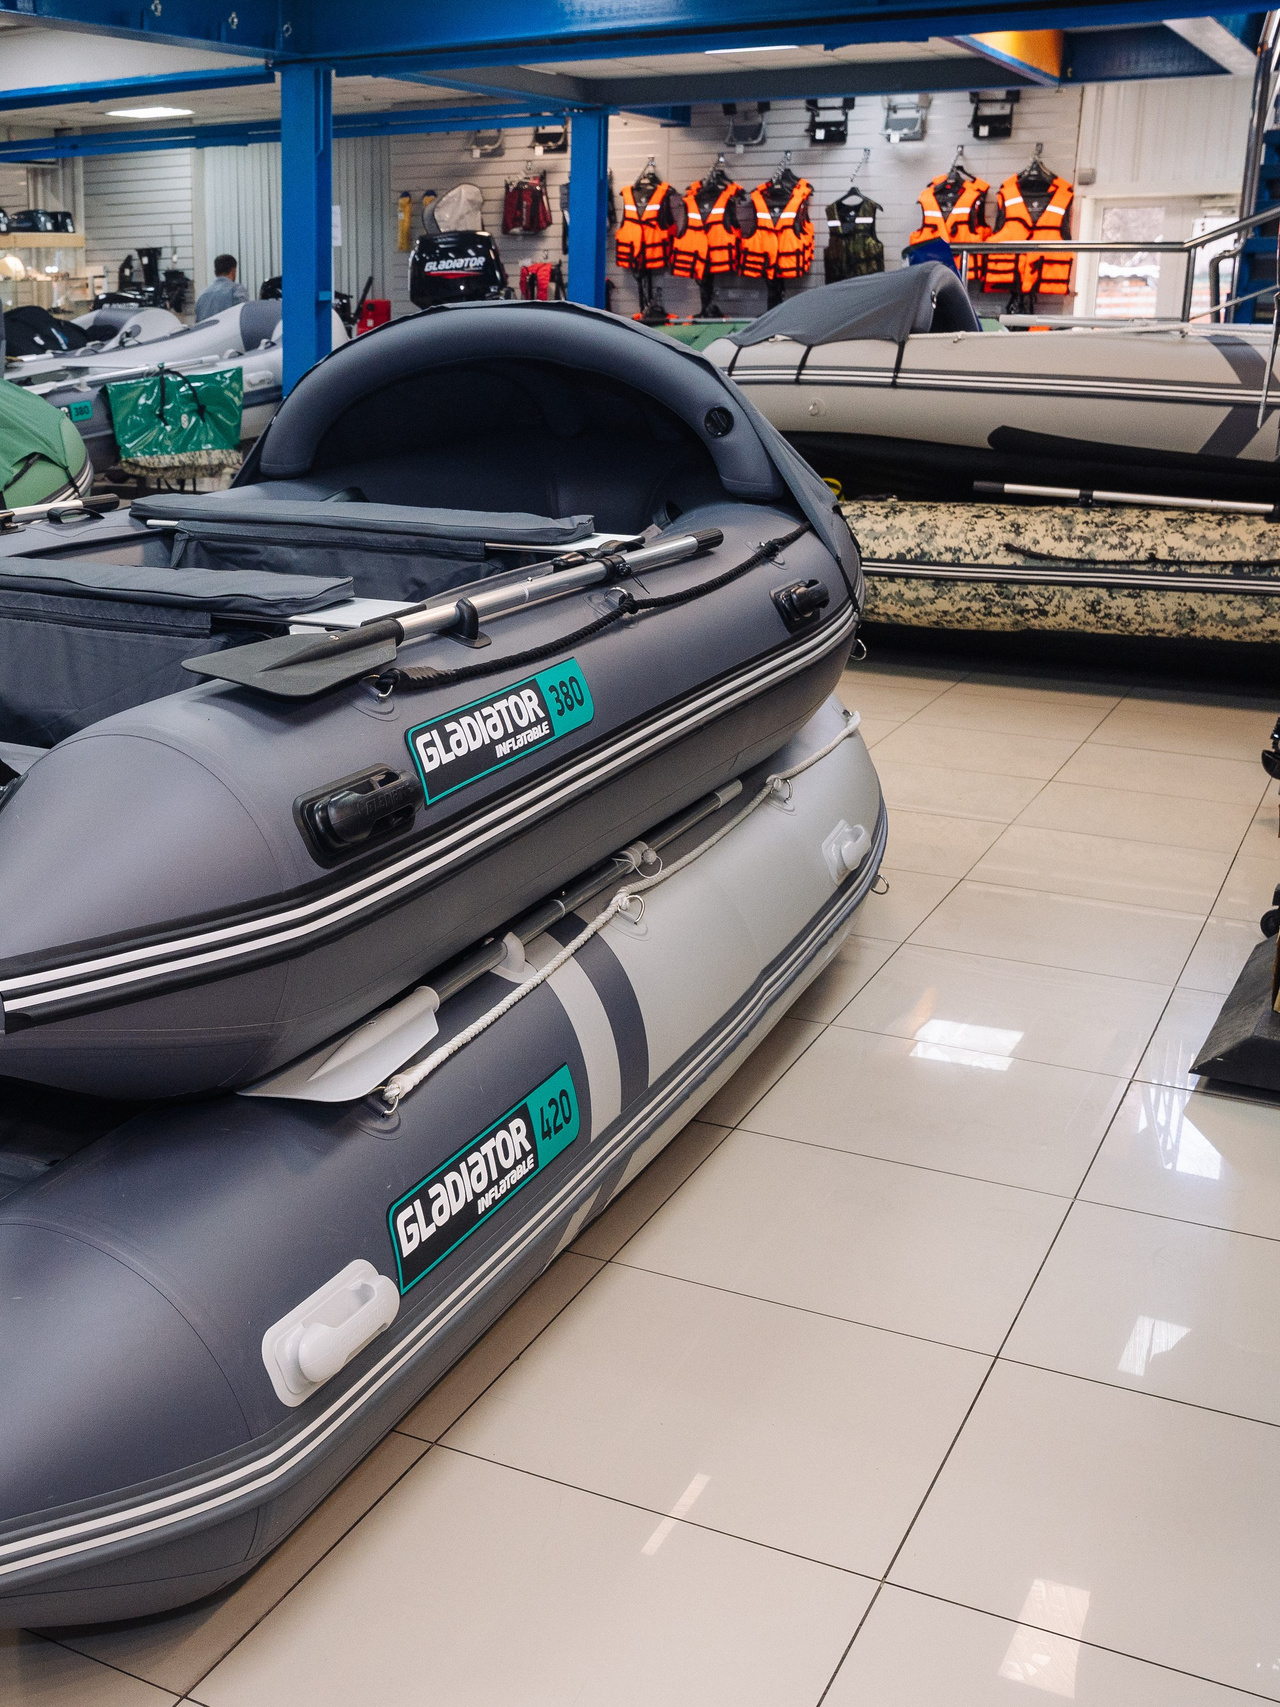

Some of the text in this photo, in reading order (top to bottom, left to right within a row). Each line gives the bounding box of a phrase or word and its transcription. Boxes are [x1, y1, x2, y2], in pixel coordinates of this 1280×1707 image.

[424, 256, 486, 272] GLADIATOR
[415, 676, 585, 773] GLADIATOR 380
[495, 721, 551, 759] INFLATABLE
[396, 1088, 572, 1258] GLADIATOR 420
[477, 1153, 535, 1215] INFLATABLE
